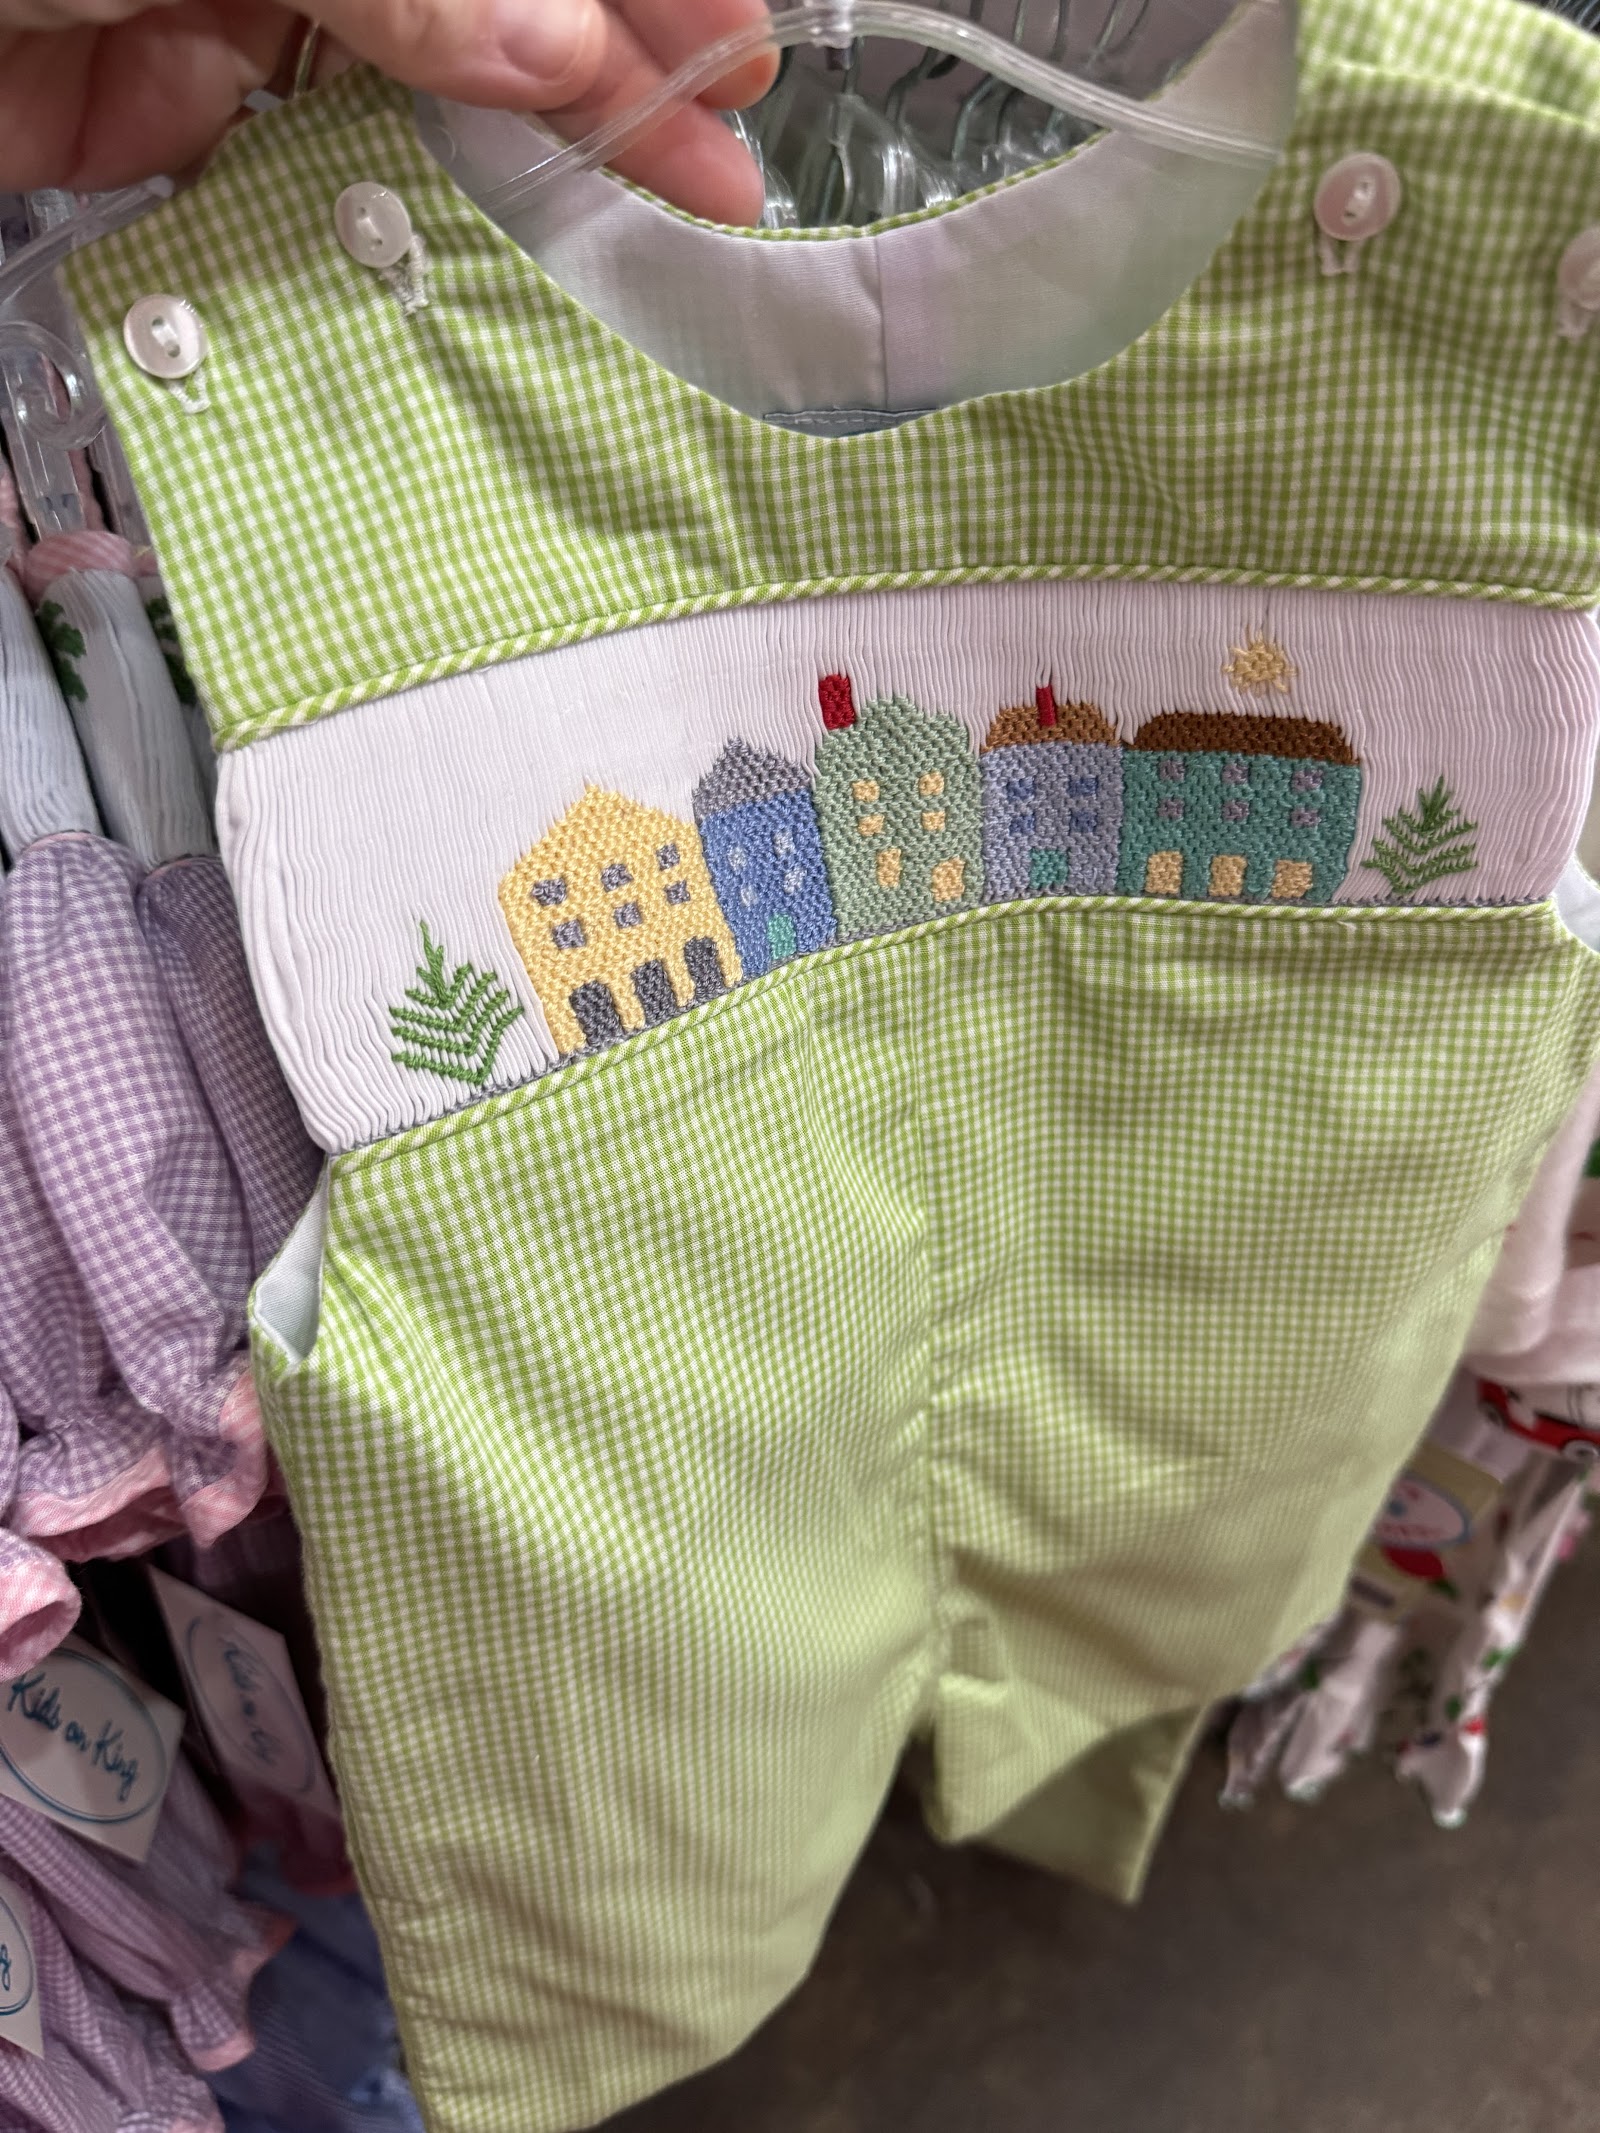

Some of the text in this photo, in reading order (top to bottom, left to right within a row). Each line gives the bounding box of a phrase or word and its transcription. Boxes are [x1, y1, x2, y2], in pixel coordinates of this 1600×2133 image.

[7, 1672, 139, 1804] Kids on King
